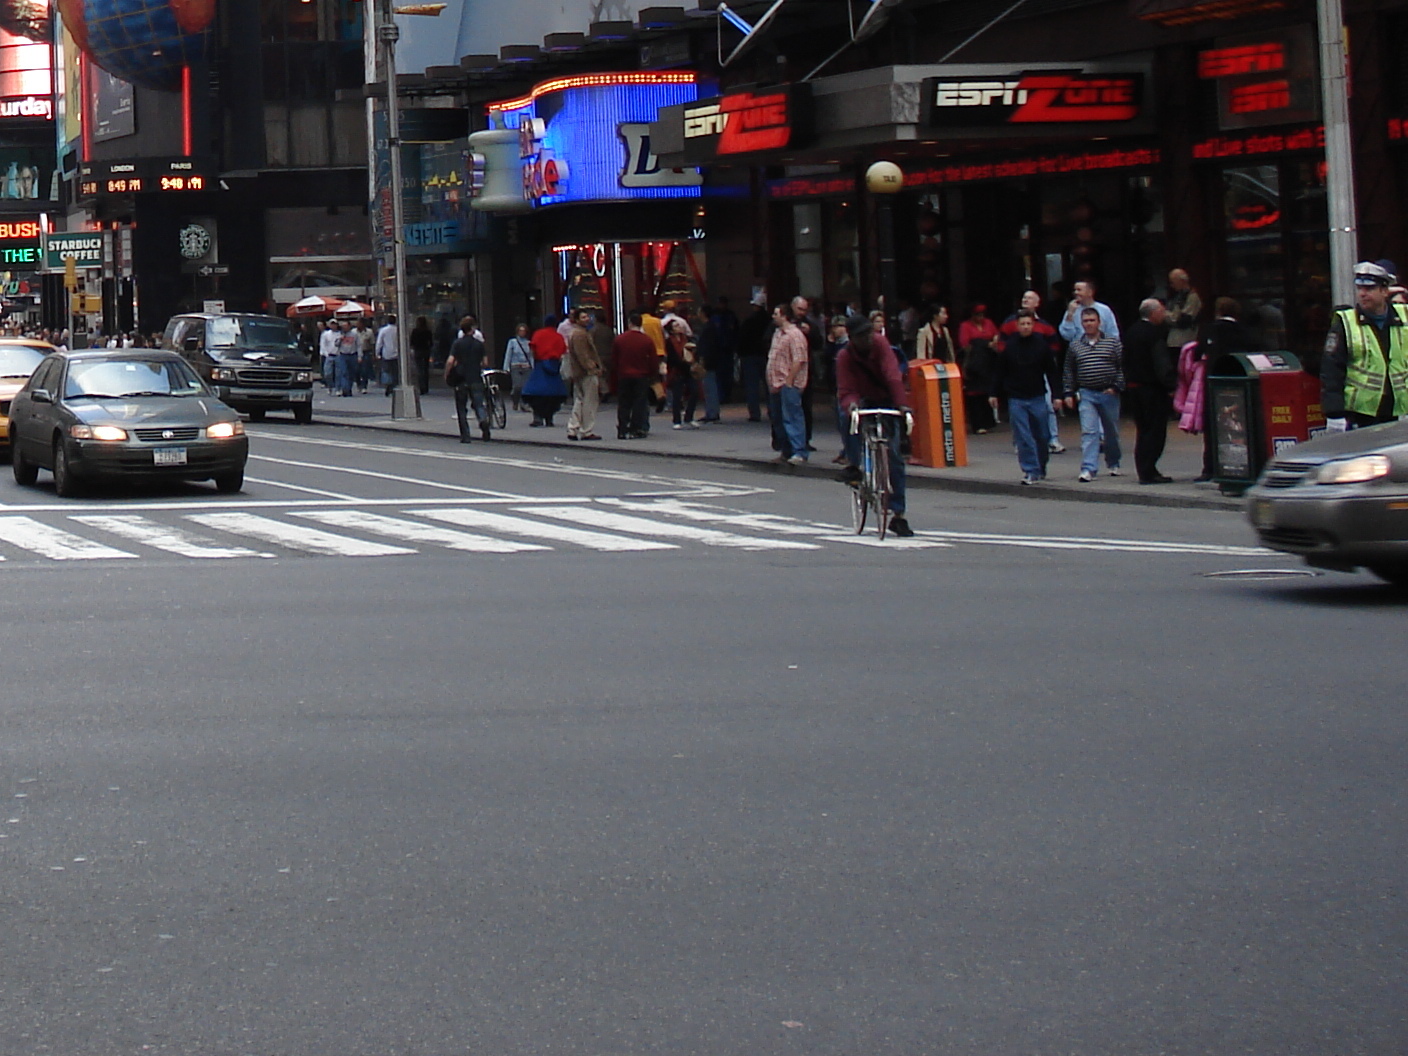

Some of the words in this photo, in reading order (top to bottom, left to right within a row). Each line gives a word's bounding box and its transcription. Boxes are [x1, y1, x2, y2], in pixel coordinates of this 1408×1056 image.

[936, 81, 1028, 107] ESPN
[0, 248, 35, 263] THE
[59, 250, 100, 261] COFFEE
[941, 392, 952, 424] metro
[1271, 415, 1292, 423] DAILY
[944, 429, 955, 462] metro
